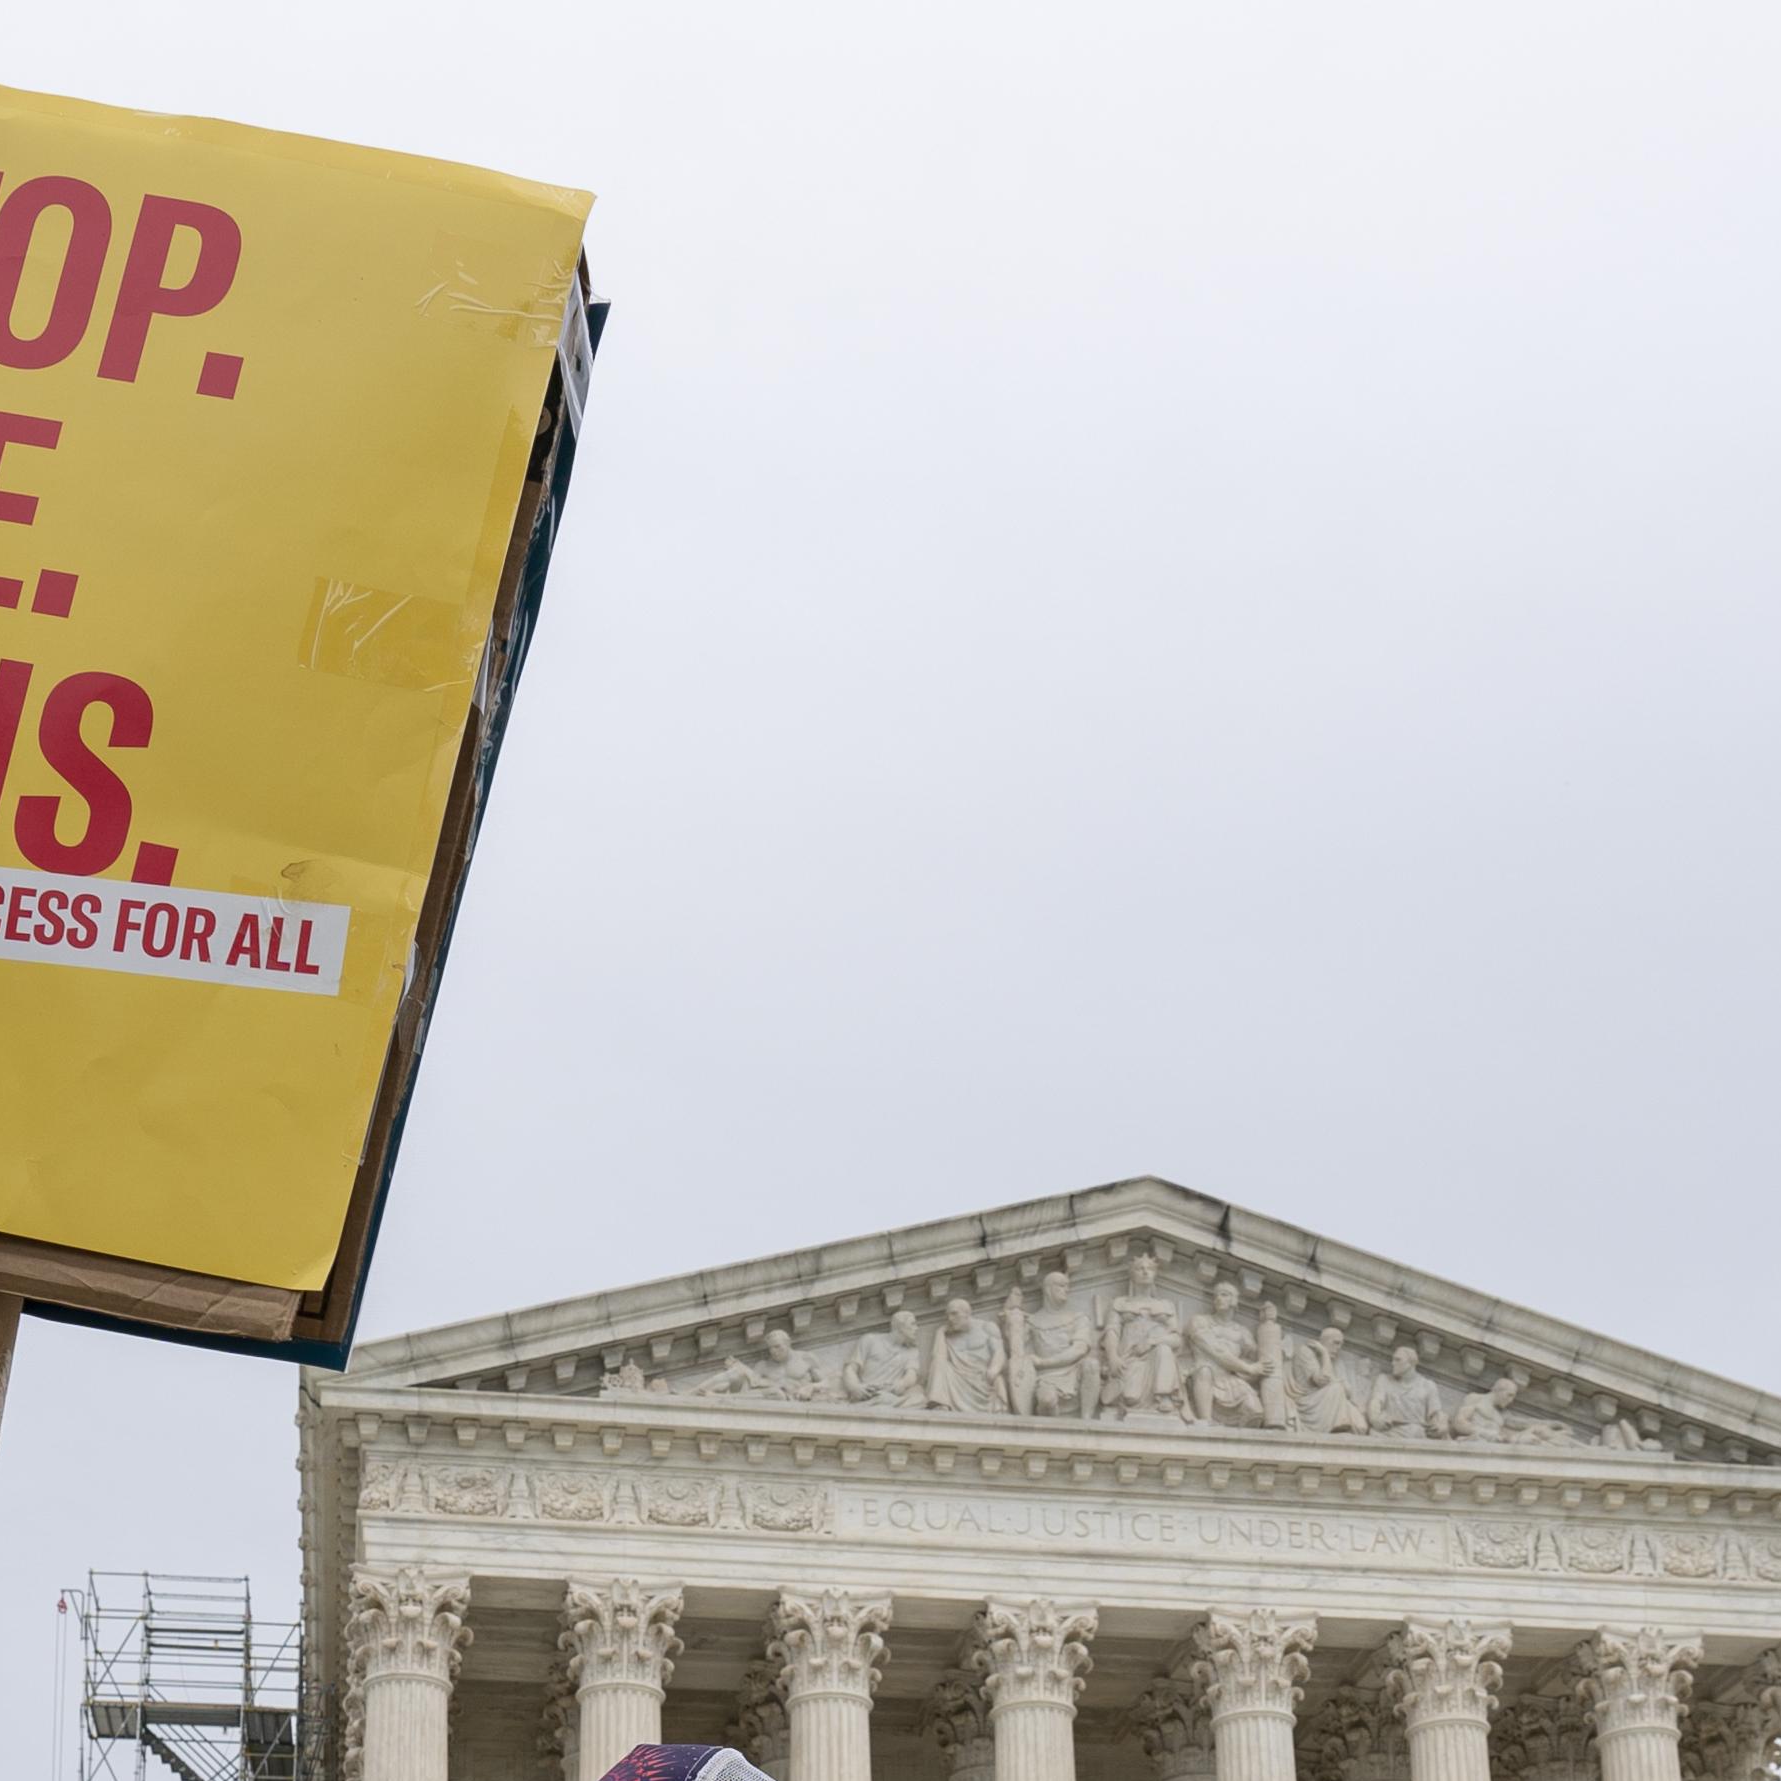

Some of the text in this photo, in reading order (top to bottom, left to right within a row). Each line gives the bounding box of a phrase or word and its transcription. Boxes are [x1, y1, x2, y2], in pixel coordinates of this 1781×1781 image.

[114, 897, 216, 961] FOR
[228, 912, 320, 975] ALL
[863, 1499, 1424, 1554] EQUAL JUSTICE UNDER LAW
